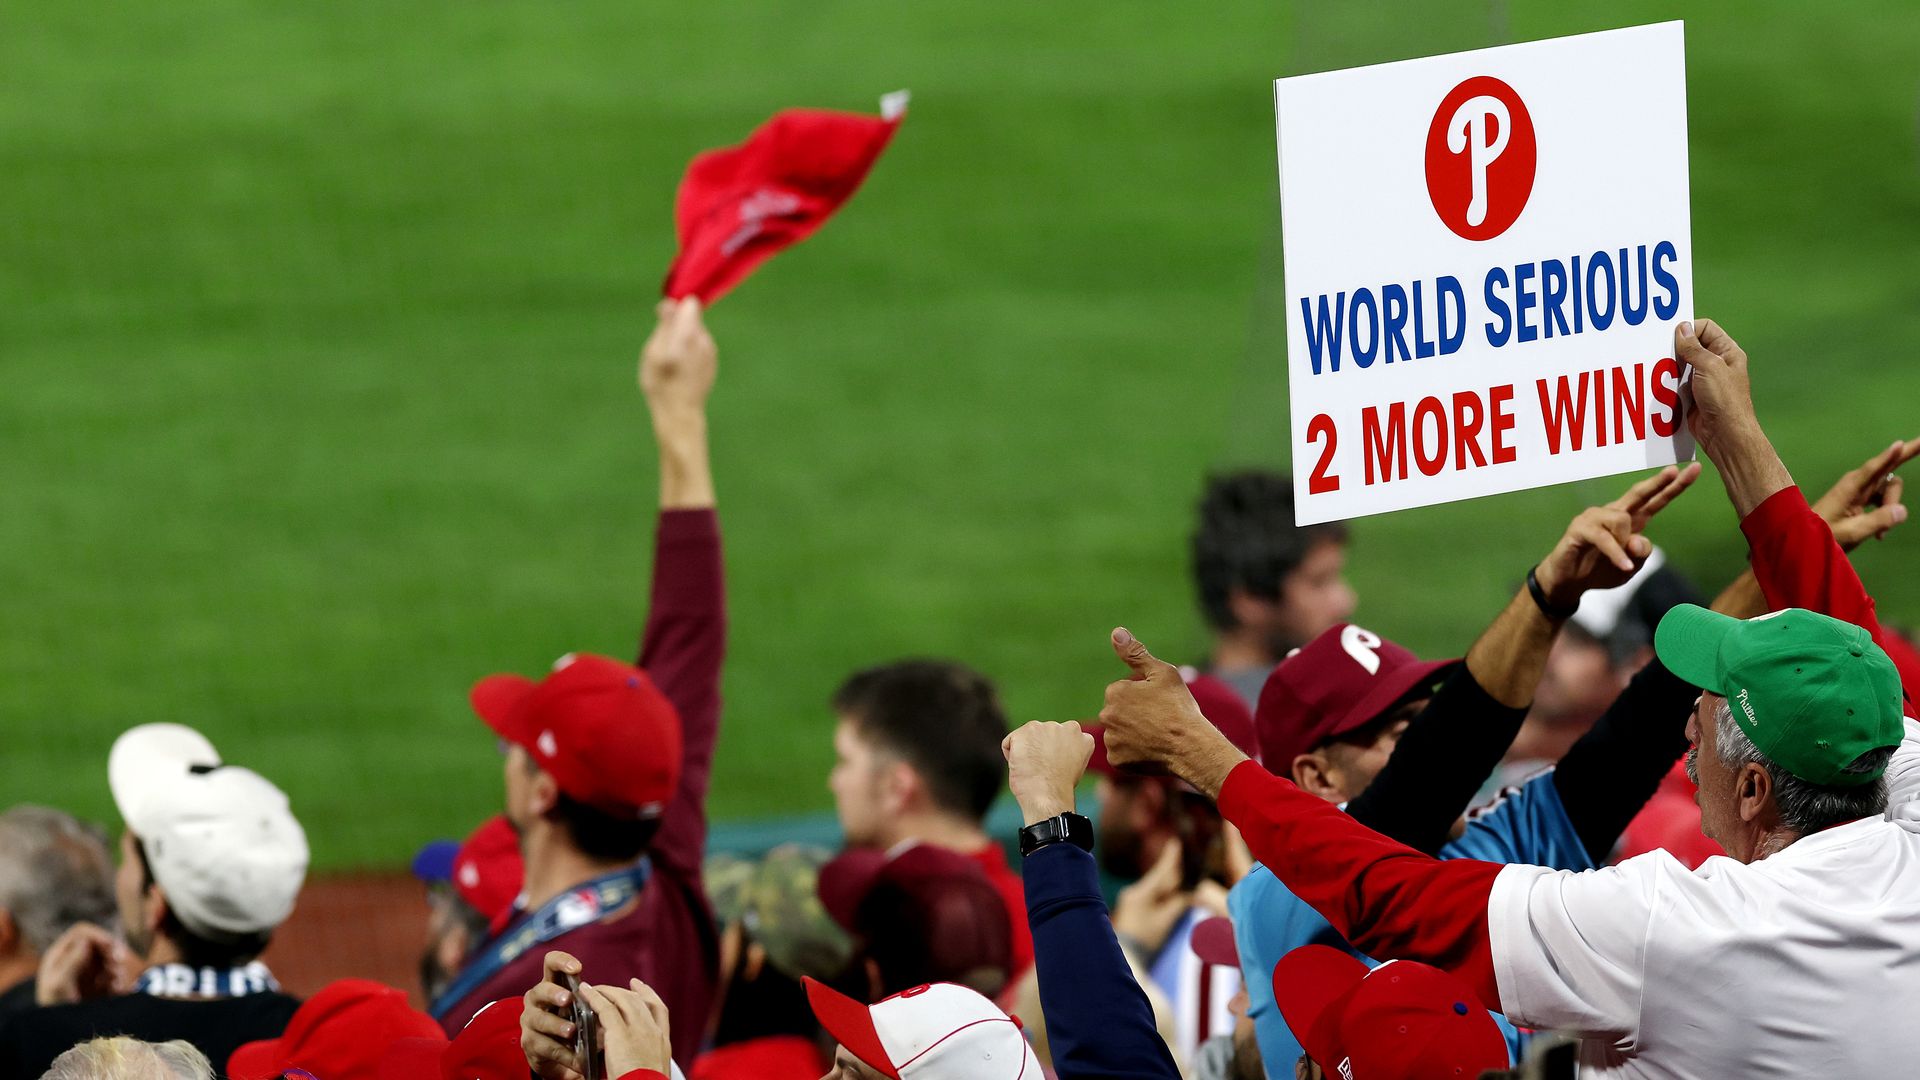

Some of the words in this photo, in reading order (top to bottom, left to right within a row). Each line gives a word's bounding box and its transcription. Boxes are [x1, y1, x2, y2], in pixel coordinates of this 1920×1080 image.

[1301, 275, 1467, 376] WORLD
[1484, 240, 1681, 348] SERIOUS
[1306, 413, 1340, 495] 2
[1361, 383, 1518, 486] MORE
[1536, 357, 1682, 456] WINS
[1736, 688, 1758, 727] Phillies
